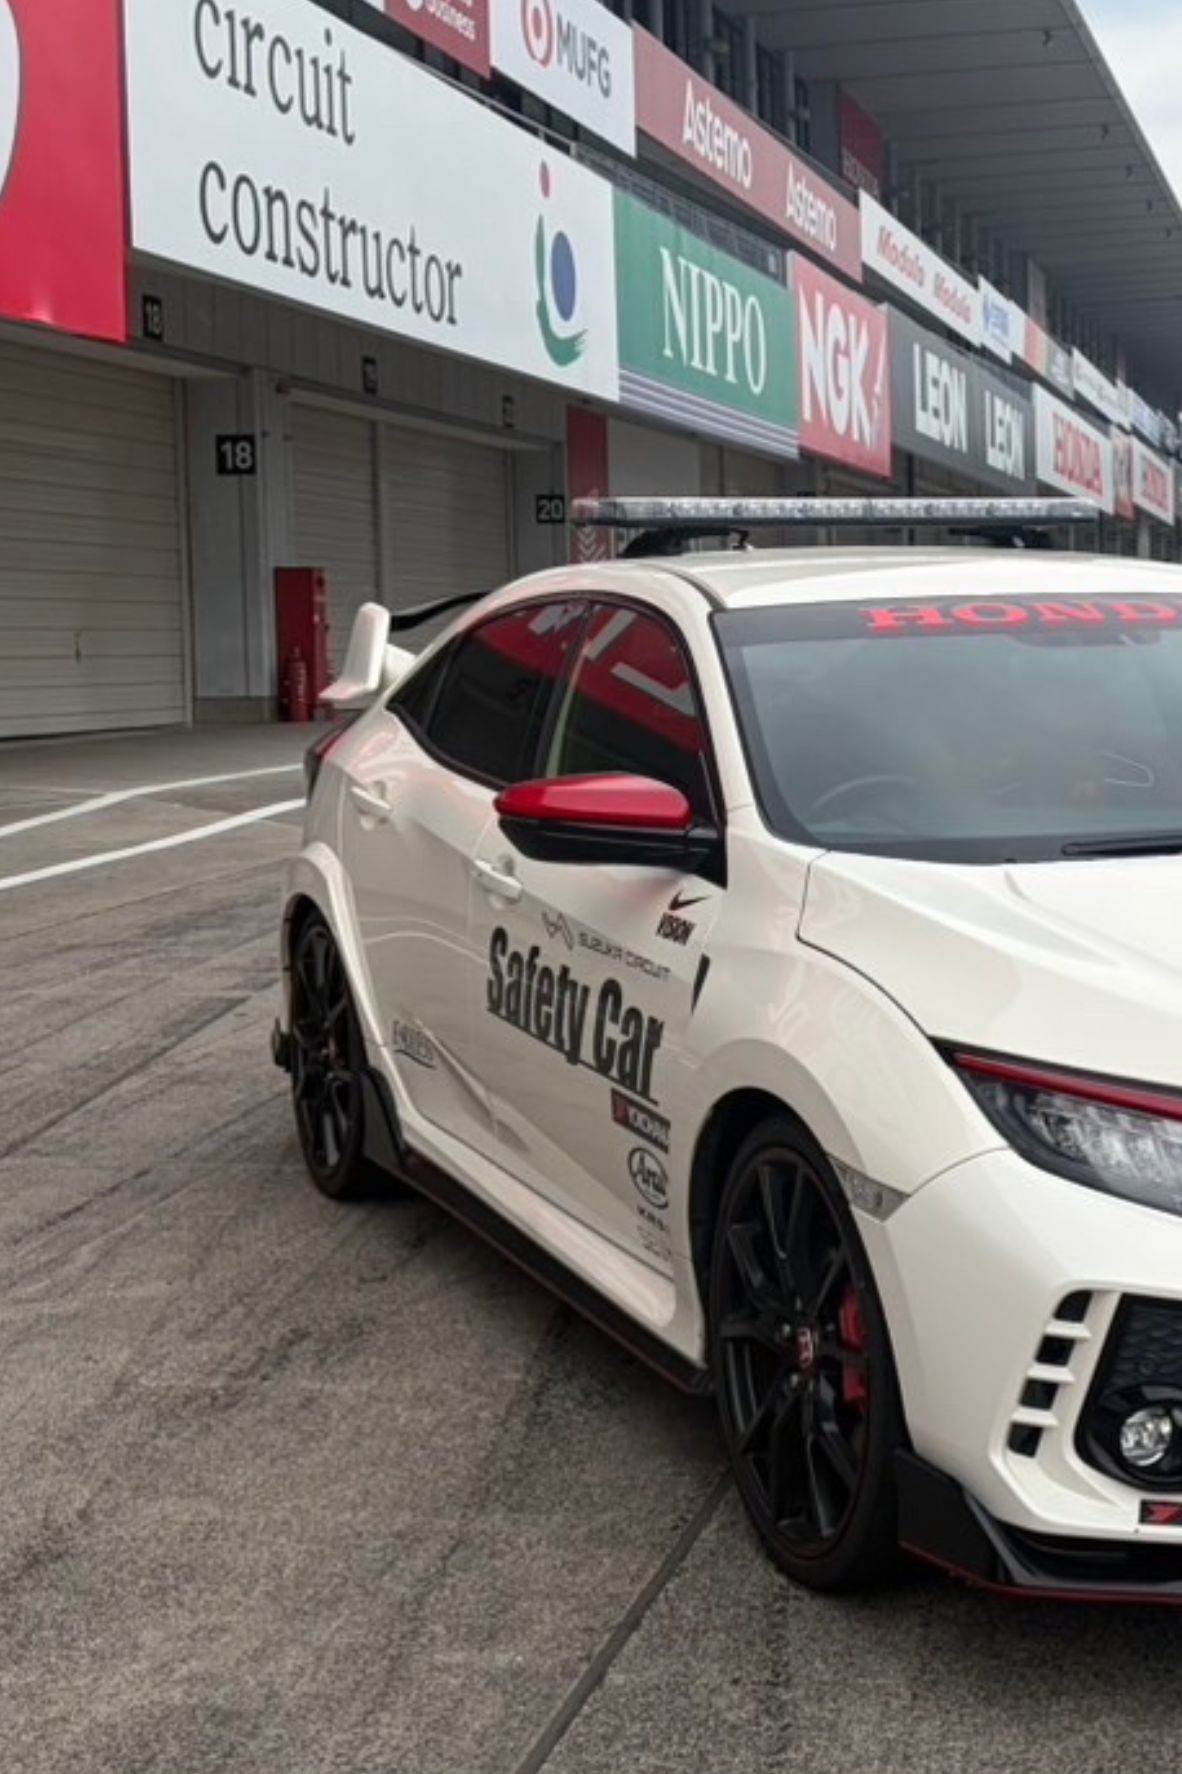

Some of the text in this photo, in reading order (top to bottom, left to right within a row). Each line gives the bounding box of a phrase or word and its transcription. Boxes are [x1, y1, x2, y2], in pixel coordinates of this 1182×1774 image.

[194, 0, 356, 145] circuit
[556, 13, 612, 99] MUFG
[682, 78, 754, 190] Astemo
[199, 161, 463, 326] constructor
[785, 160, 837, 250] Astemo
[659, 245, 767, 396] NIPPO
[798, 283, 872, 451] NGK
[913, 340, 968, 454] LEON
[985, 388, 1026, 482] LEON
[220, 440, 254, 471] 18
[537, 498, 564, 521] 20
[487, 925, 665, 1098] Safety Car
